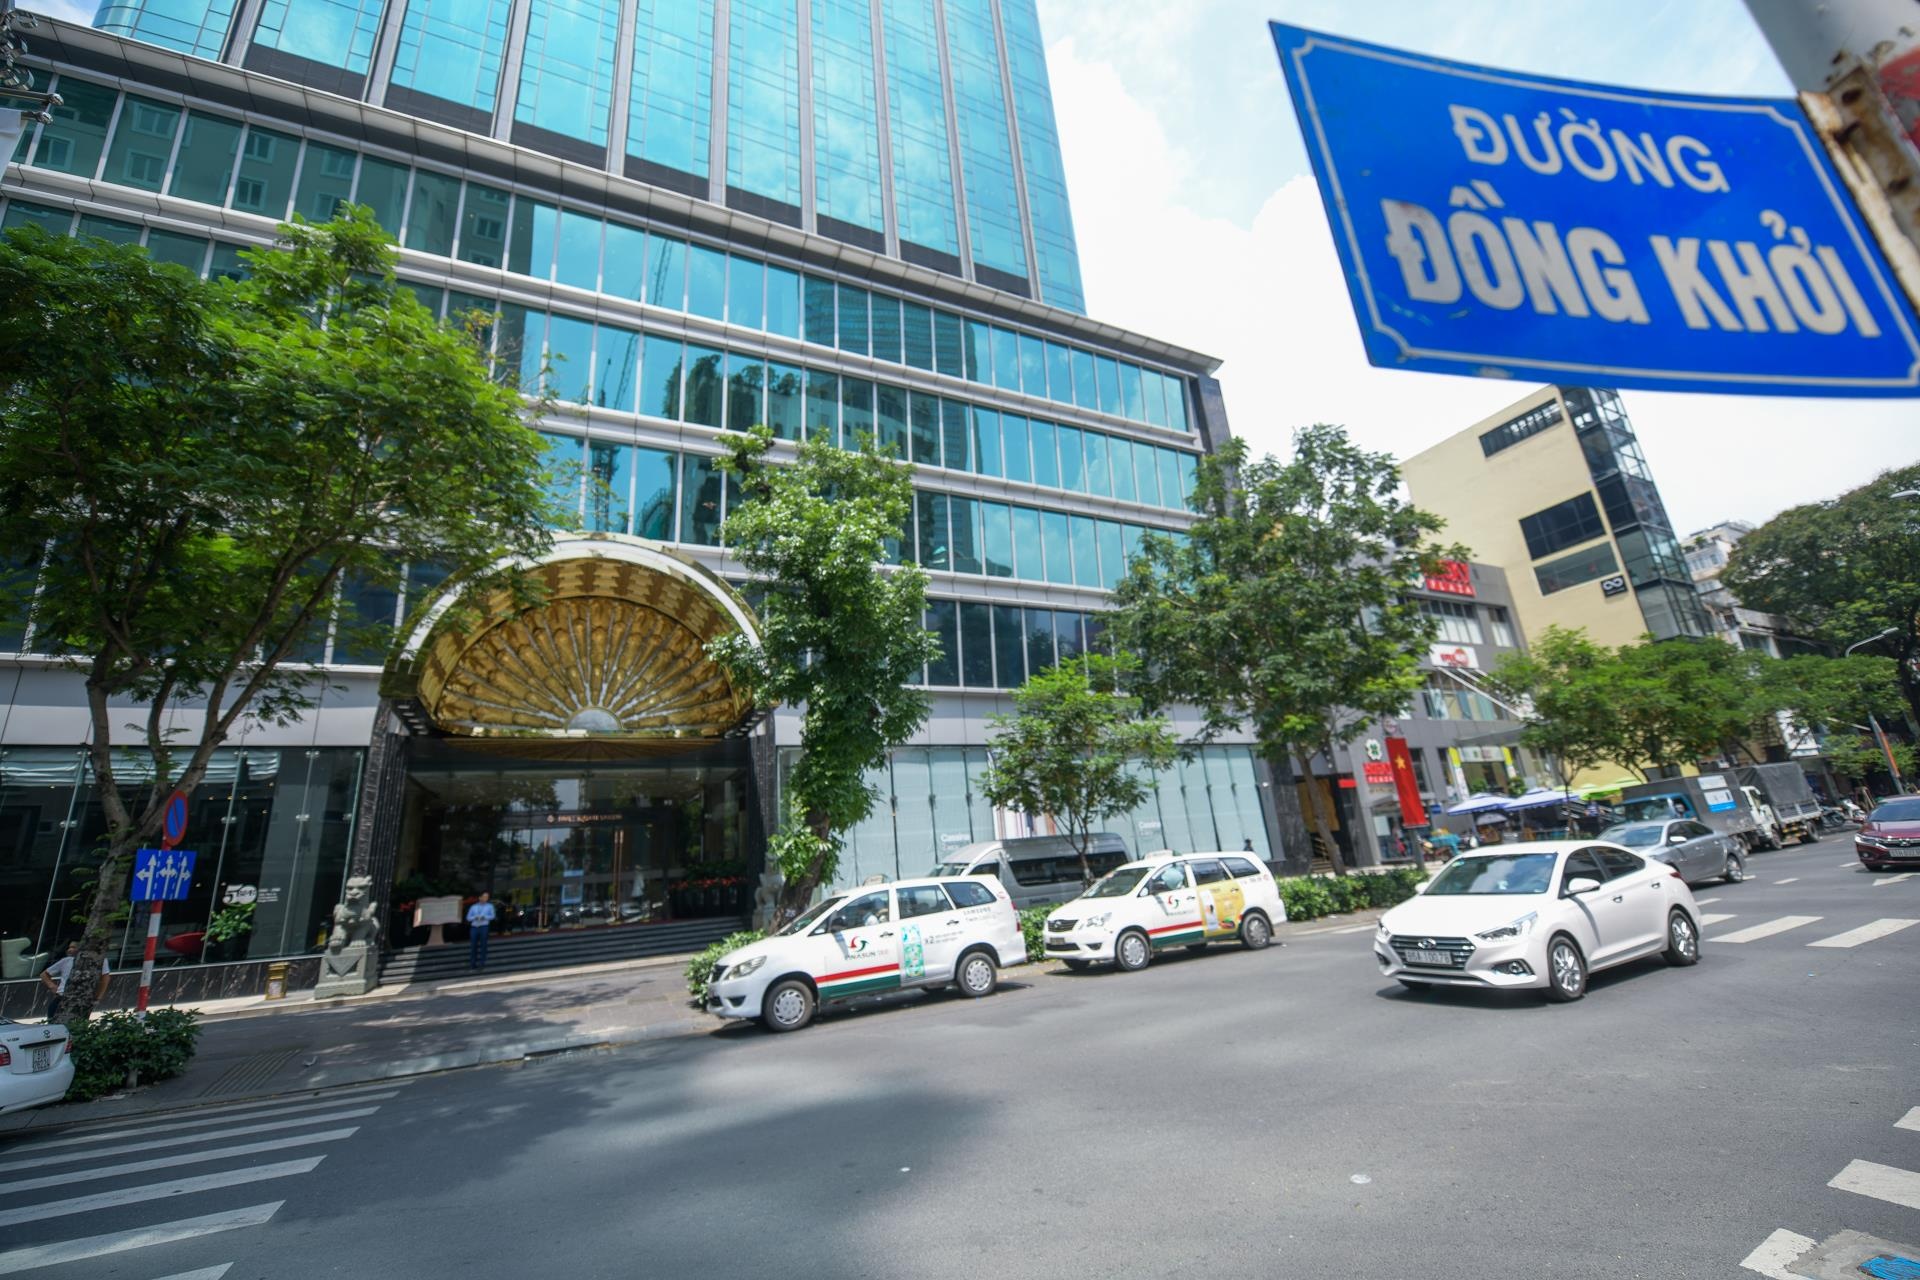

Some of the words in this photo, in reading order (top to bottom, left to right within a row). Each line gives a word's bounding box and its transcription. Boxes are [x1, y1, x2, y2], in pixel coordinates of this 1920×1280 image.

[1448, 103, 1731, 194] ĐƯỜNG
[1380, 180, 1651, 325] ĐỒNG
[1648, 209, 1882, 339] KHỞI
